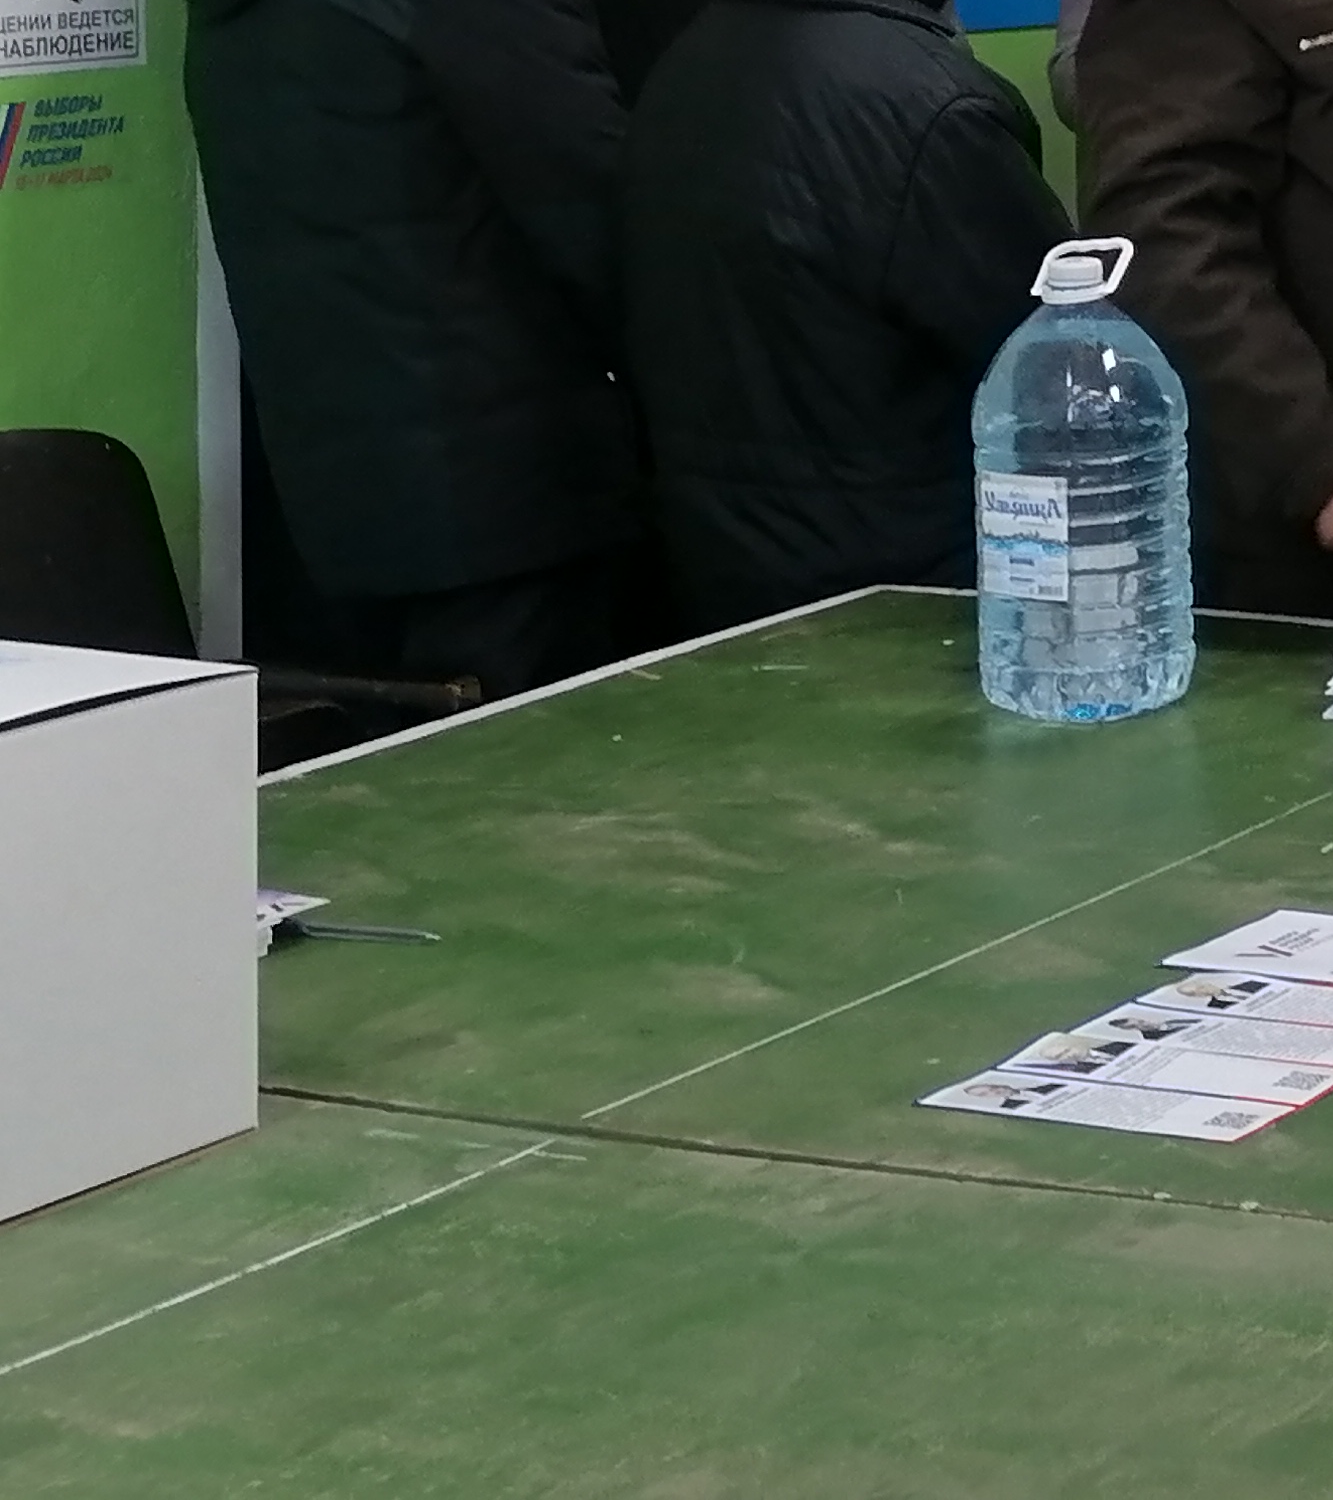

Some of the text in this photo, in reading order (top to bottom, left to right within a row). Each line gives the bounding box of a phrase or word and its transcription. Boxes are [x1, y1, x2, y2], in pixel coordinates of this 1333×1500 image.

[0, 8, 134, 35] ЕНИИ ВЕДЕТСЯ
[34, 93, 103, 118] ВЫБОРЫ
[26, 115, 124, 143] ПРЕЗИДЕНТА
